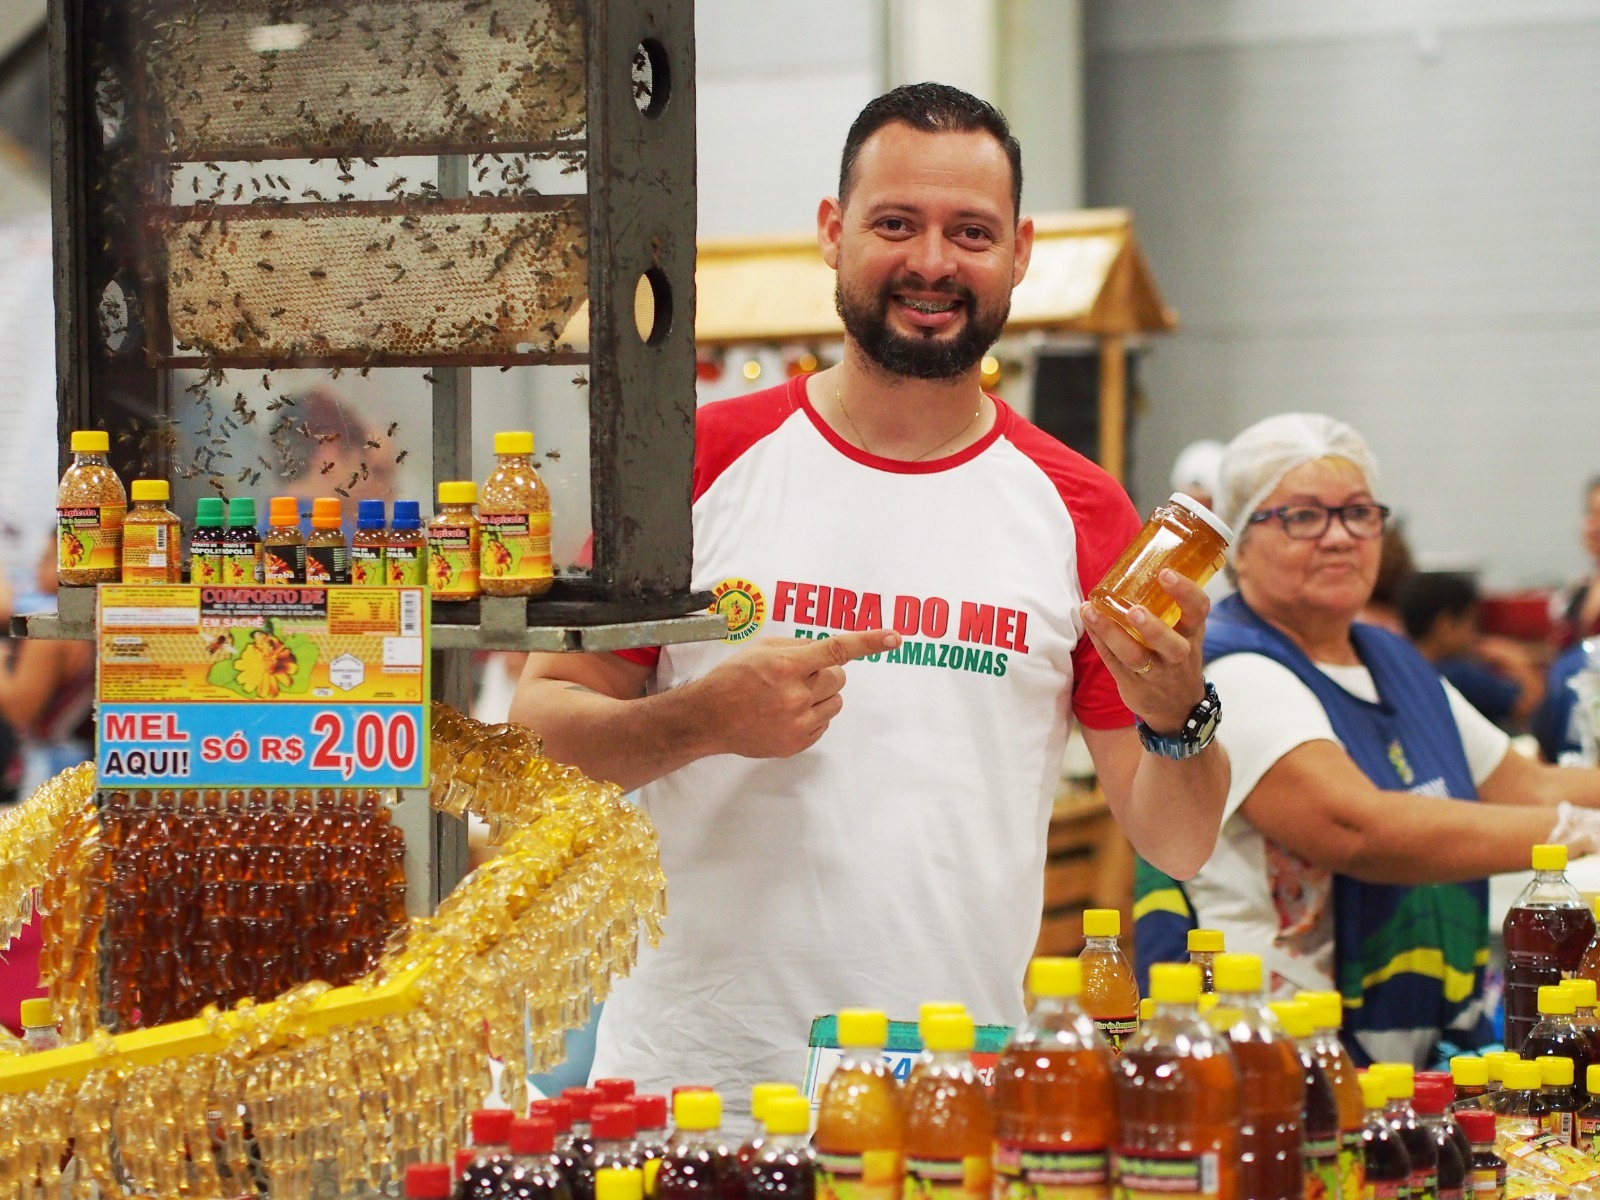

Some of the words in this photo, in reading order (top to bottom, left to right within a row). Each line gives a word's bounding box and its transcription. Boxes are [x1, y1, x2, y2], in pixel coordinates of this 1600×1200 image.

[201, 589, 299, 604] COMPOSTO
[300, 589, 325, 604] DE
[202, 618, 221, 628] EM
[772, 580, 882, 632] FEIRA
[893, 595, 950, 639] DO
[958, 601, 1029, 655] MEL
[886, 641, 1009, 677] AMAZONAS
[105, 714, 188, 742] MEL
[202, 732, 248, 762] SÓ
[261, 736, 304, 764] R$
[311, 712, 416, 779] 2,00
[104, 751, 189, 777] AQUI!
